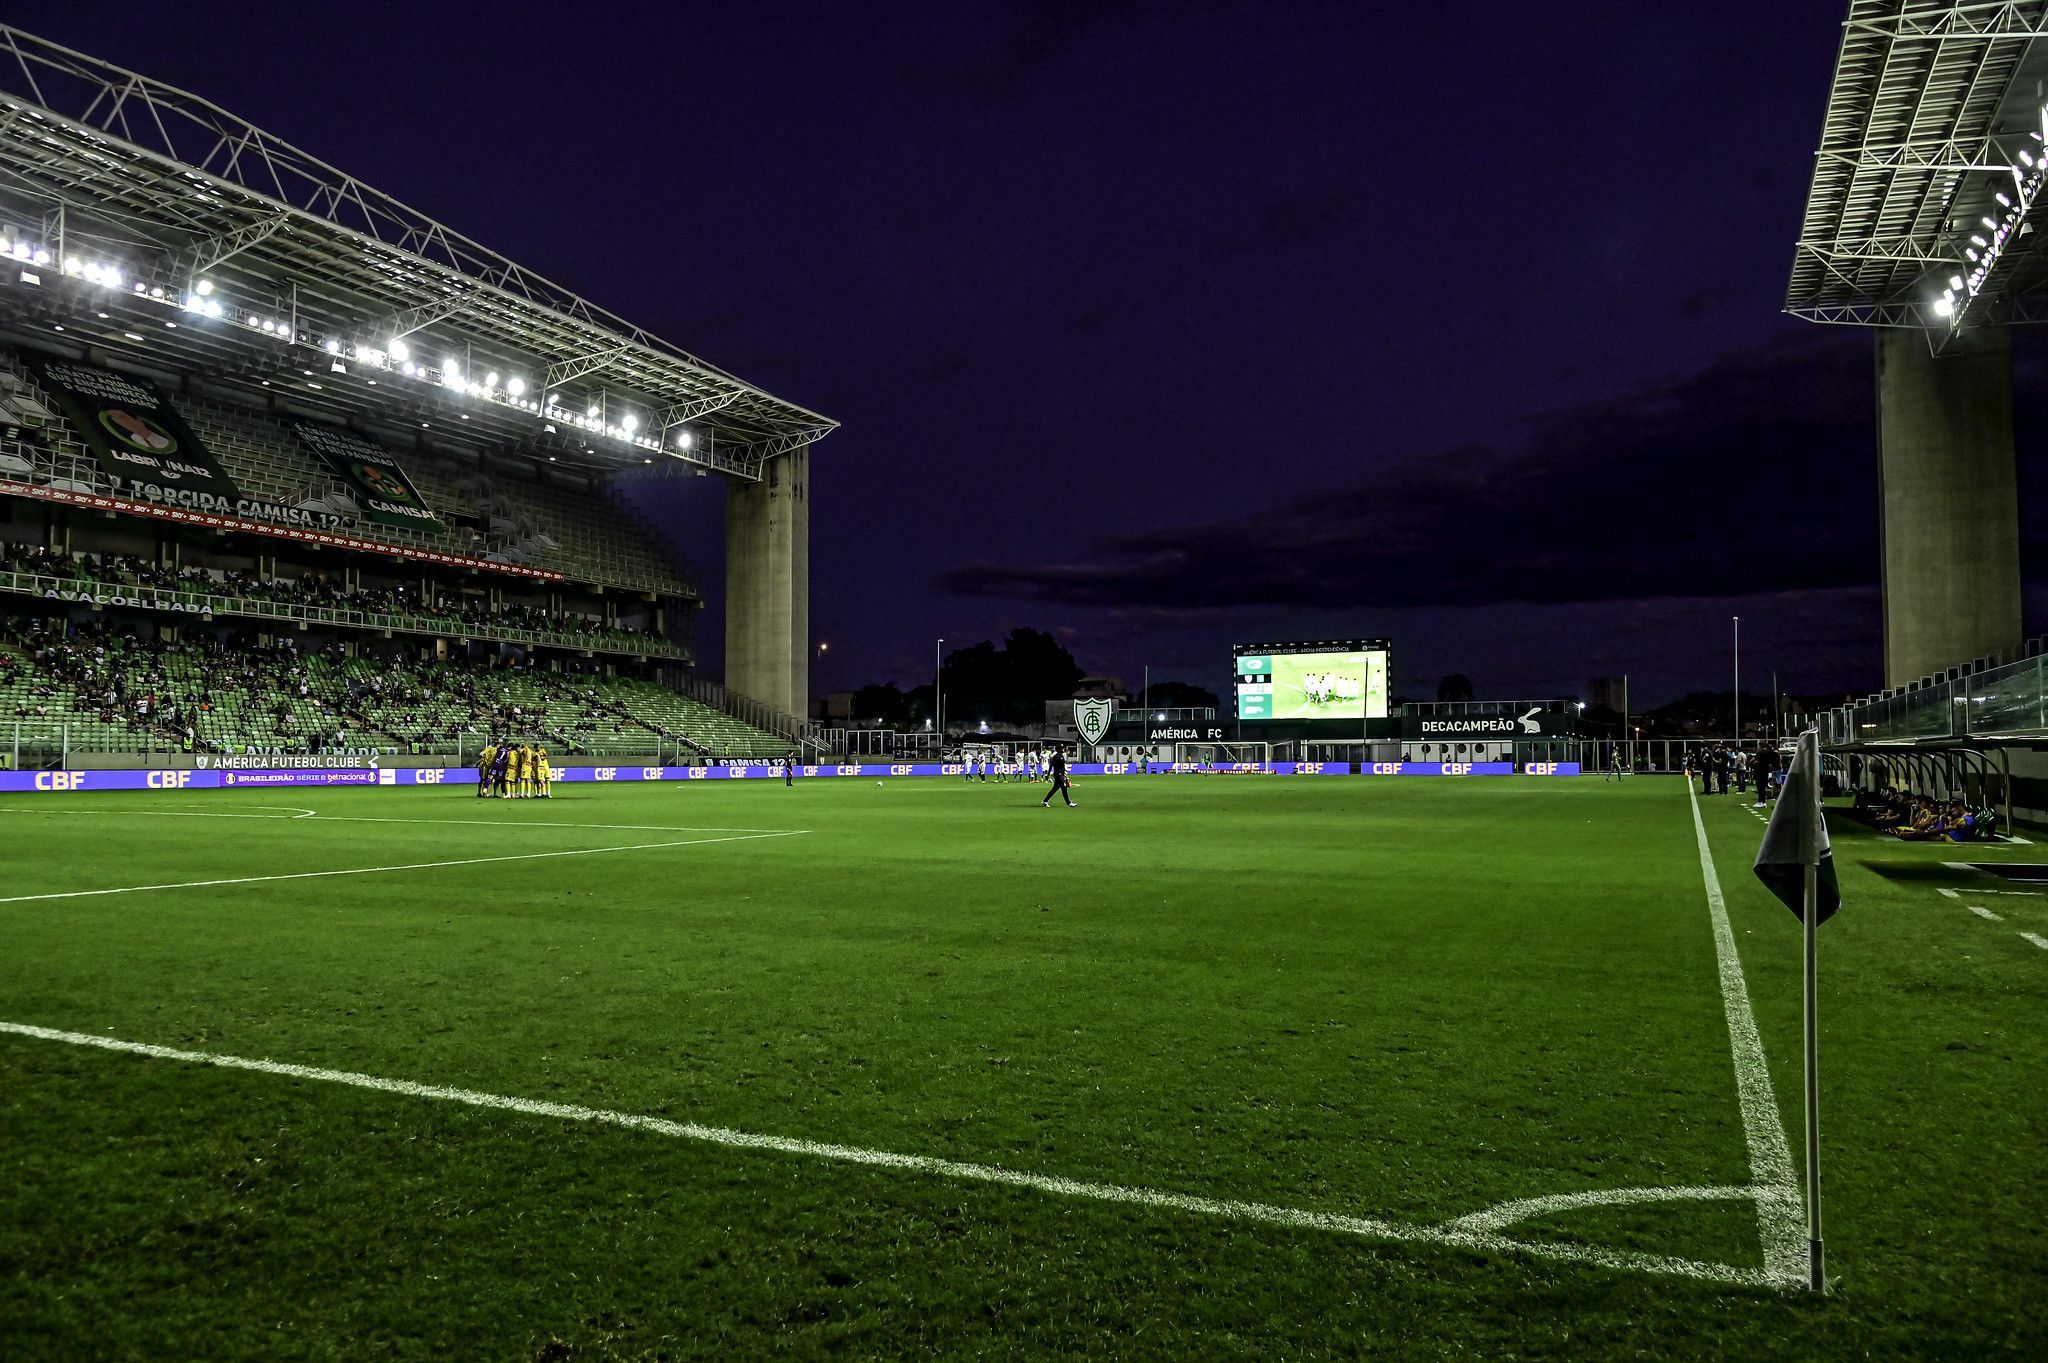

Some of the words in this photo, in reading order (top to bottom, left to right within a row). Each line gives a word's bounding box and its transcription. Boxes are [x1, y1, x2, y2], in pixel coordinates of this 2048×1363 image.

[131, 480, 230, 513] TORCIDA
[237, 499, 313, 527] CAMISA
[32, 488, 50, 496] SKY+
[53, 492, 71, 500] SKY+
[74, 495, 92, 503] SKY+
[95, 498, 111, 507] SKY+
[114, 502, 131, 510] SKY+
[134, 505, 150, 513] SKY+
[153, 508, 169, 516] SKY+
[171, 511, 187, 519] SKY+
[189, 514, 204, 522] SKY+
[207, 517, 222, 525] SKY+
[224, 520, 239, 528] SKY+
[241, 522, 255, 530] SKY+
[257, 525, 272, 533] SKY+
[289, 531, 303, 539] SKY+
[44, 589, 213, 614] AVACOELHADA
[1422, 718, 1514, 732] DECACAMPEÃO
[1151, 726, 1198, 739] AMÉRICA
[1207, 729, 1222, 739] FC
[213, 755, 269, 769] AMÉRICA
[271, 756, 324, 768] FUTEBOL
[326, 756, 361, 768] CLUBE
[719, 758, 771, 767] CAMISA
[549, 768, 565, 781] BF
[595, 768, 616, 780] CBF
[643, 767, 663, 779] CBF
[689, 767, 707, 778] CBF
[730, 767, 747, 778] CBF
[768, 766, 785, 777] CBF
[804, 766, 818, 776] CBF
[837, 765, 861, 775] CBF
[891, 765, 913, 775] CBF
[942, 764, 964, 774] CBF
[1104, 764, 1129, 774] CBF
[1297, 763, 1323, 774] CBF
[1373, 763, 1402, 775] CBF
[1442, 763, 1472, 775] CBF
[1525, 763, 1557, 775] CBF
[35, 771, 85, 790] CBF
[147, 771, 191, 789] CBF
[238, 773, 295, 782] BRASILEIRÃO
[296, 773, 320, 781] SÉRIE
[327, 773, 367, 783] betnacional
[416, 768, 444, 784] CBF
